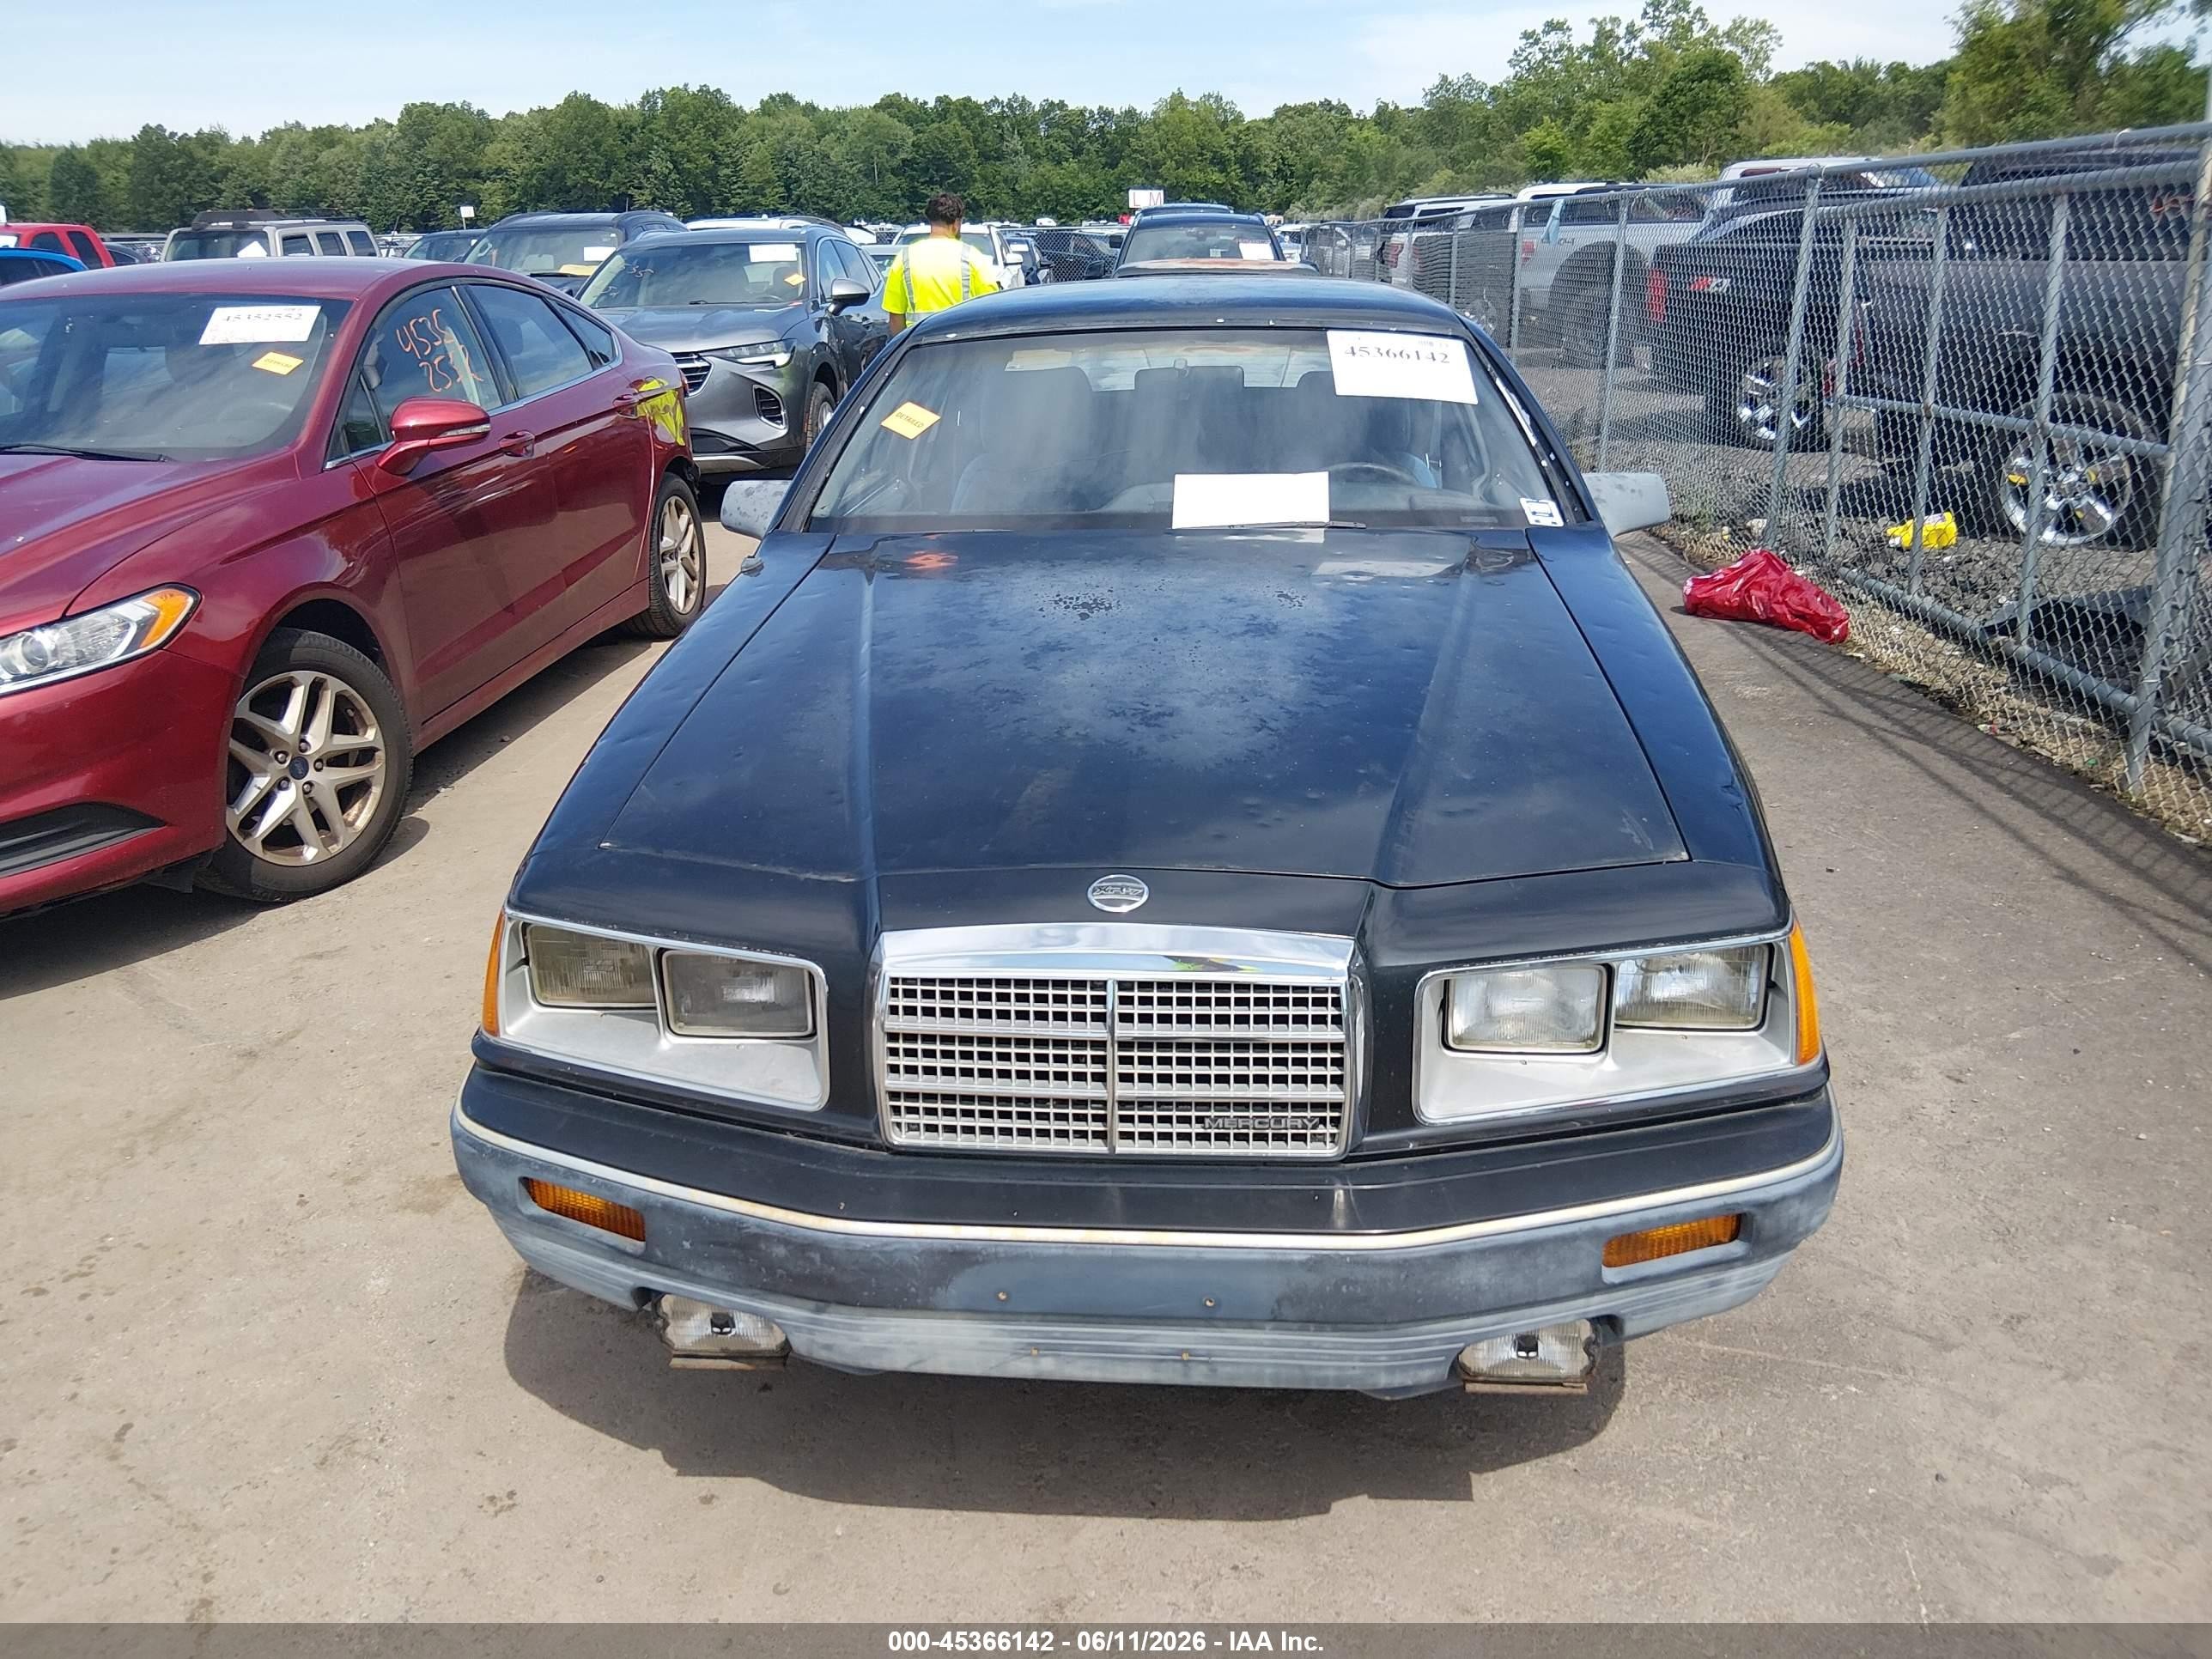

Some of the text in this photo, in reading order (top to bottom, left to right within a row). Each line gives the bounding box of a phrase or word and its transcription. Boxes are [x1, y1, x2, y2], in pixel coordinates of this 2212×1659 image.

[1133, 191, 1162, 206] L M
[1344, 345, 1450, 364] 45366142
[1204, 1117, 1320, 1129] MERCURY
